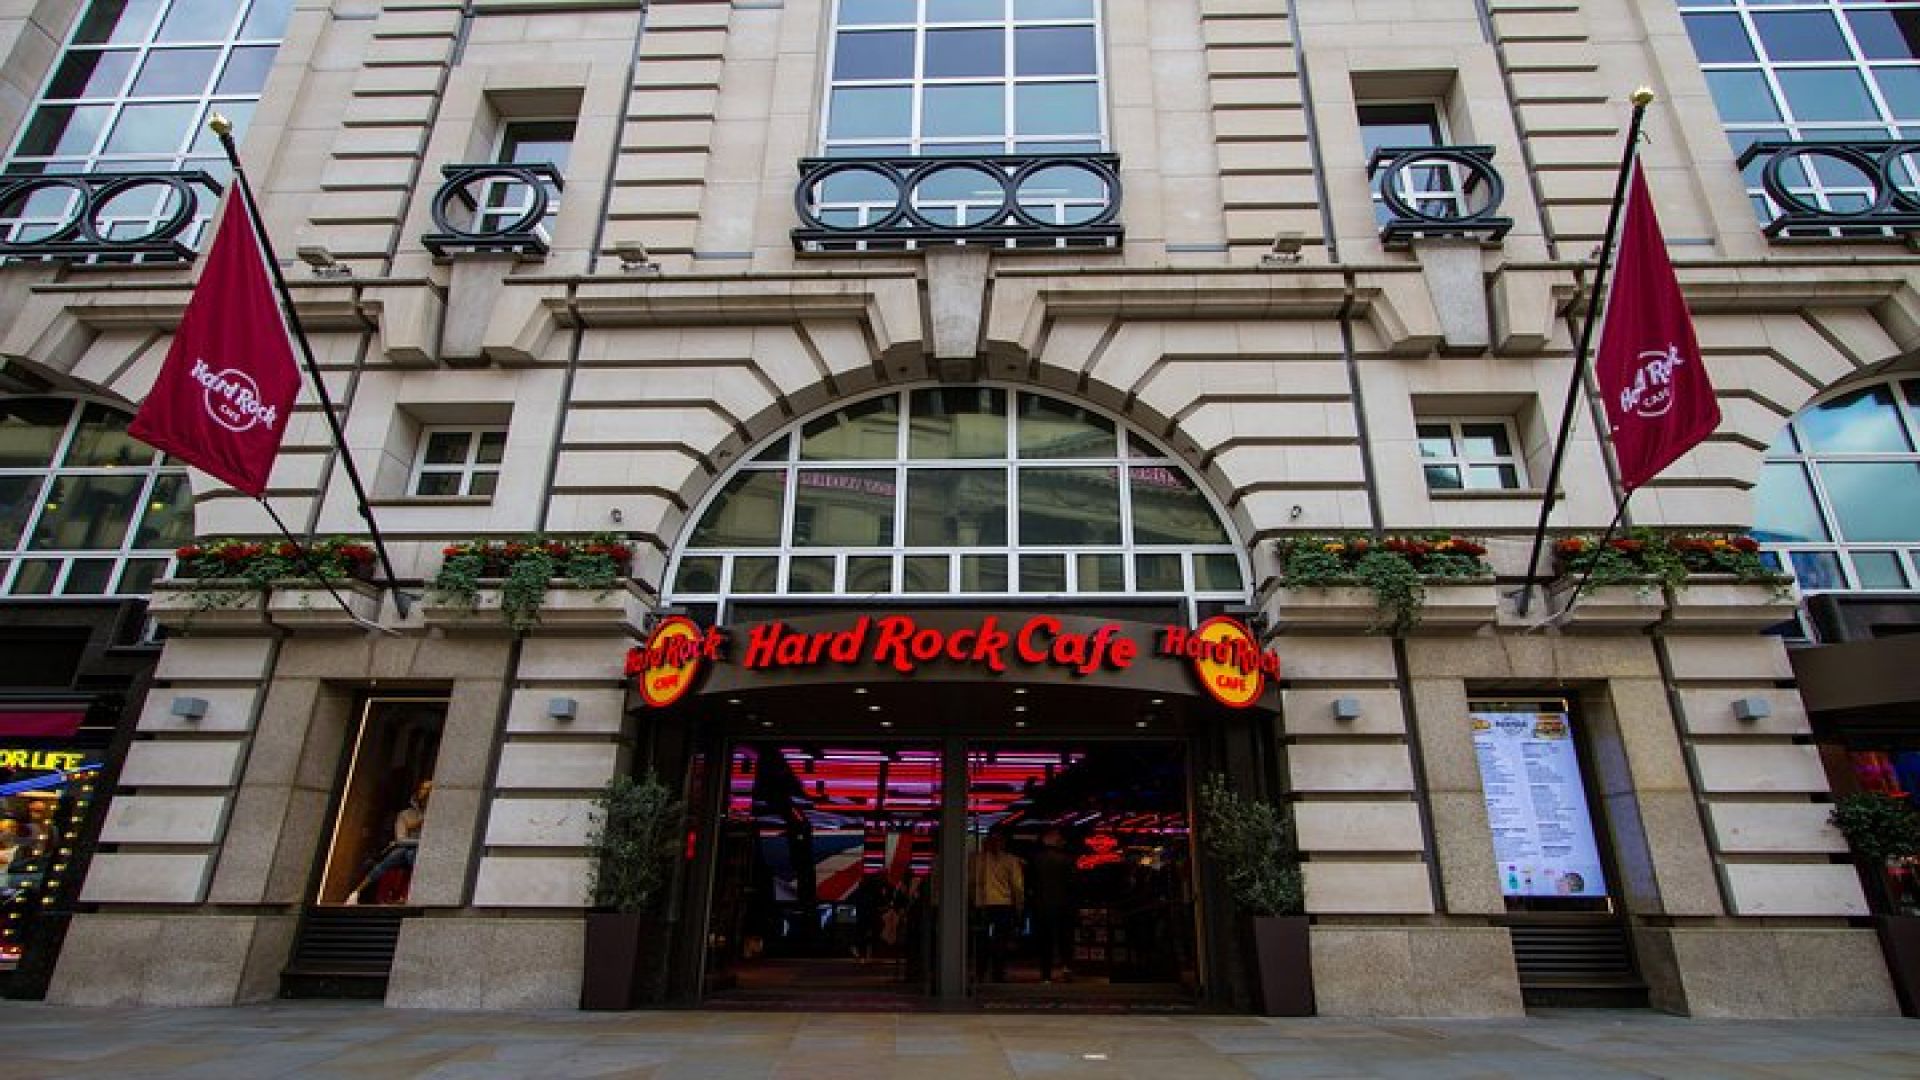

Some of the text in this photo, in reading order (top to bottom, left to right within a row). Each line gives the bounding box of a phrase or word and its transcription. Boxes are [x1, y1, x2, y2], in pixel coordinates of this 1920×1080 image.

[191, 358, 276, 430] Hard Rock
[743, 614, 1137, 674] Hard Rock Cafe
[1164, 625, 1230, 664] Hard
[1216, 675, 1246, 691] CAFE
[31, 751, 86, 772] LIFE
